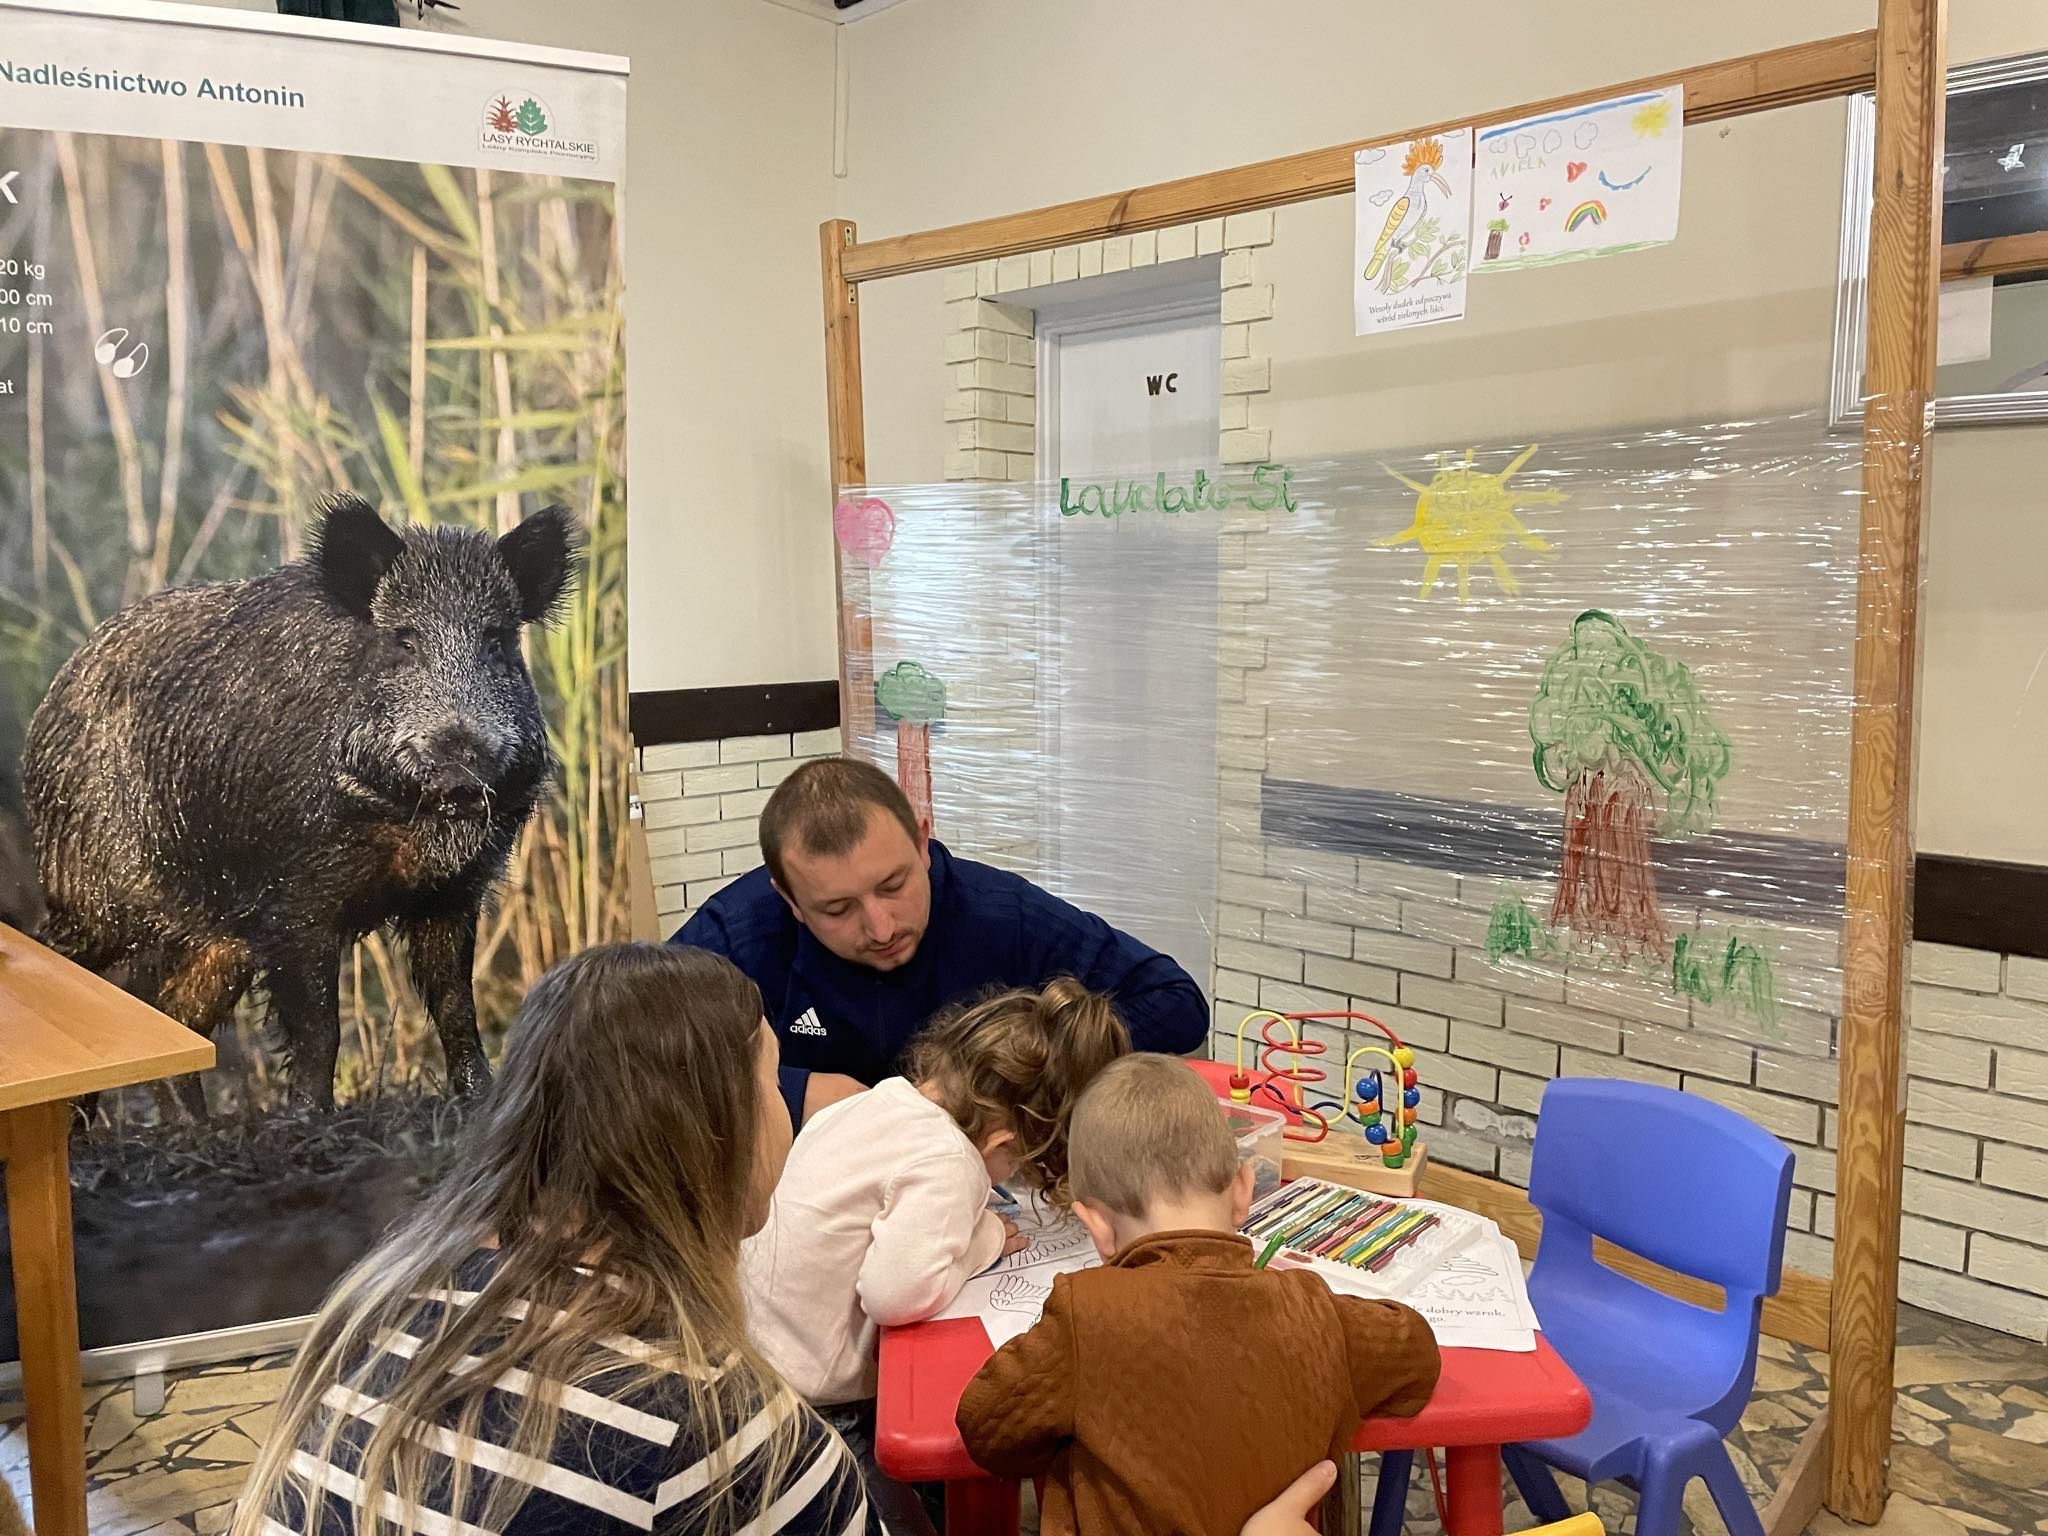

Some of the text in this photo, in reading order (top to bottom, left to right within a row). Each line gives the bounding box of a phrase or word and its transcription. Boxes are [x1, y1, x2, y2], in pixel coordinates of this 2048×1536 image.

[0, 61, 305, 108] Nadleśnictwo Antonin
[483, 133, 595, 153] LASY RYCHTALSKIE
[24, 260, 45, 280] kg
[26, 293, 53, 306] cm
[26, 321, 53, 335] cm
[1146, 372, 1178, 396] WC
[790, 1024, 827, 1036] adidas
[1426, 1306, 1462, 1317] dobry
